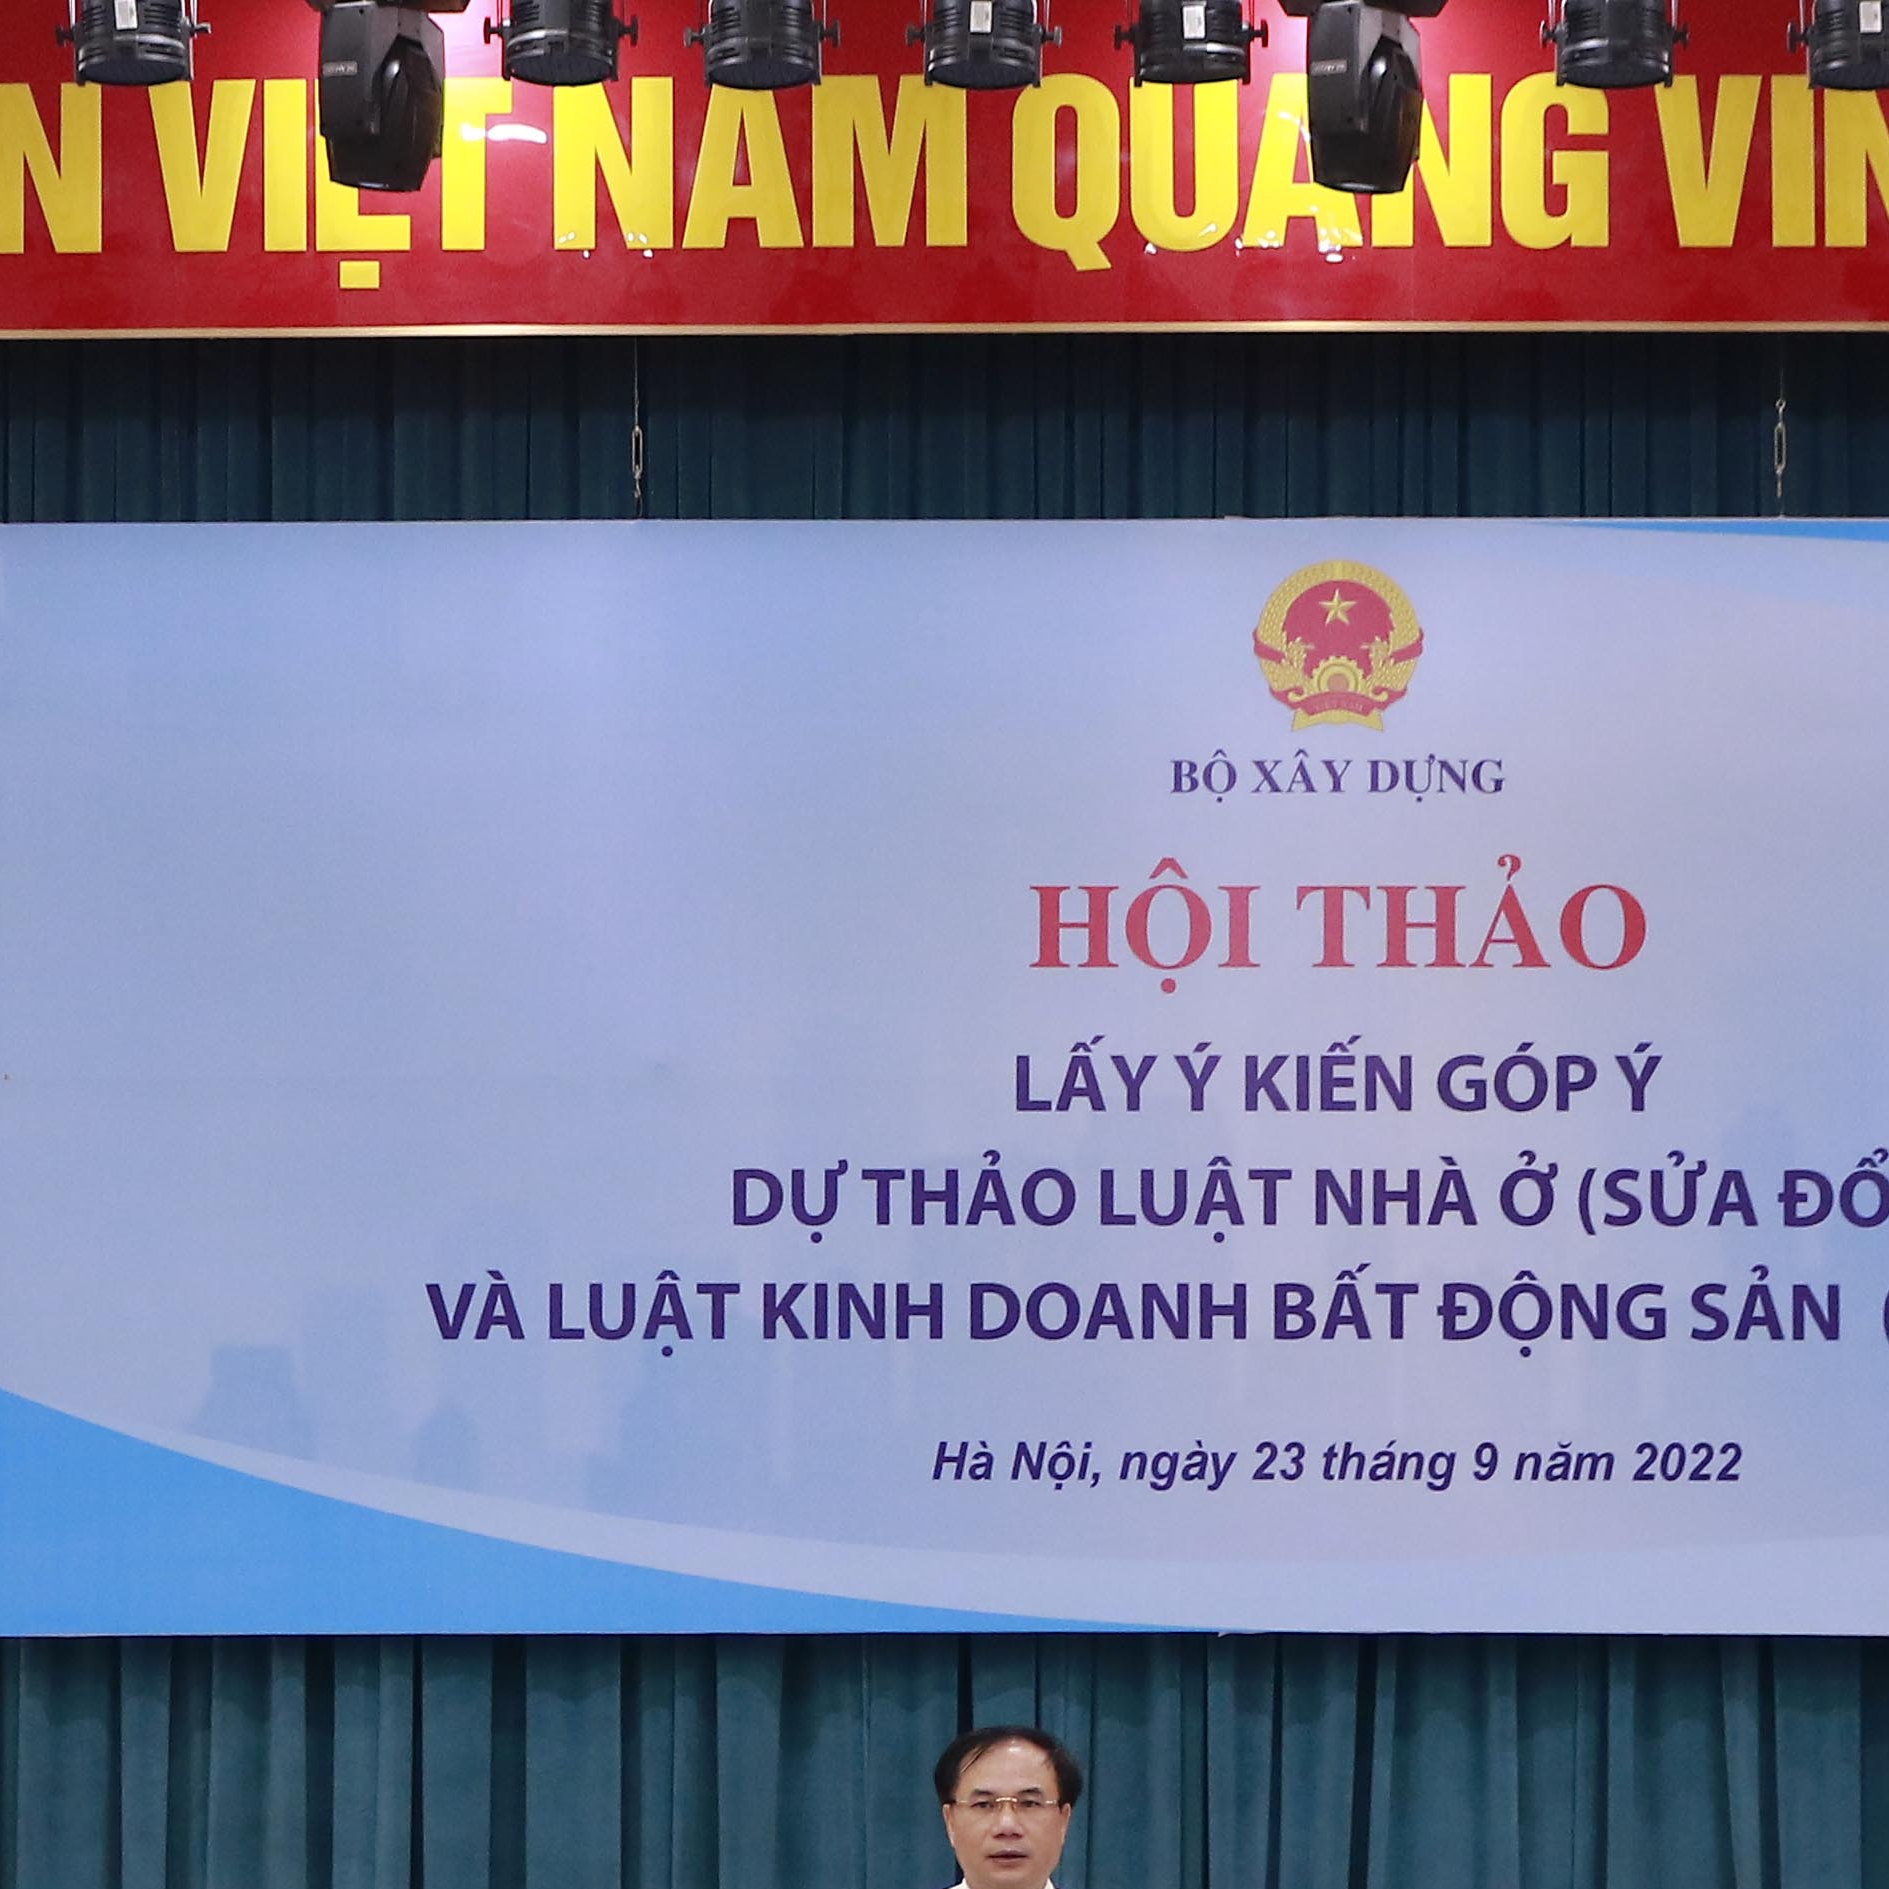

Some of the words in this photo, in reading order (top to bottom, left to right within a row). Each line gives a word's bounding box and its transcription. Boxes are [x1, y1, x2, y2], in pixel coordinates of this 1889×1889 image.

[553, 75, 968, 250] NAM
[1012, 72, 1610, 270] QUANG
[1170, 748, 1238, 804] BỘ
[1251, 748, 1354, 794] XÂY
[1367, 753, 1506, 804] DỰNG
[1029, 857, 1261, 994] HỘI
[1296, 854, 1647, 970] THẢO
[1016, 1035, 1158, 1112] LẤY
[1173, 1041, 1222, 1112] Ý
[1245, 1035, 1413, 1112] KIẾN
[1437, 1041, 1598, 1113] GÓP
[1616, 1041, 1663, 1112] Ý
[732, 1159, 848, 1244] DỰ
[862, 1150, 1076, 1226] THẢO
[1100, 1156, 1292, 1243] LUẬT
[1315, 1155, 1479, 1227] NHÀ
[1499, 1149, 1559, 1227] Ở
[1578, 1150, 1758, 1236] (SỬA
[425, 1269, 525, 1340] VÀ
[548, 1269, 740, 1357] LUẬT
[762, 1282, 944, 1340] KINH
[969, 1281, 1247, 1340] DOANH
[1273, 1262, 1418, 1340] BẤT
[1437, 1270, 1668, 1358] ĐỘNG
[1690, 1264, 1841, 1341] SẢN
[932, 1440, 994, 1481] Hà
[1010, 1439, 1103, 1489] Nội,
[1119, 1440, 1239, 1491] ngày
[1252, 1441, 1306, 1481] 23
[1321, 1438, 1457, 1491] tháng
[1472, 1441, 1499, 1482] 9
[1514, 1440, 1615, 1481] năm
[1633, 1442, 1744, 1482] 2022
